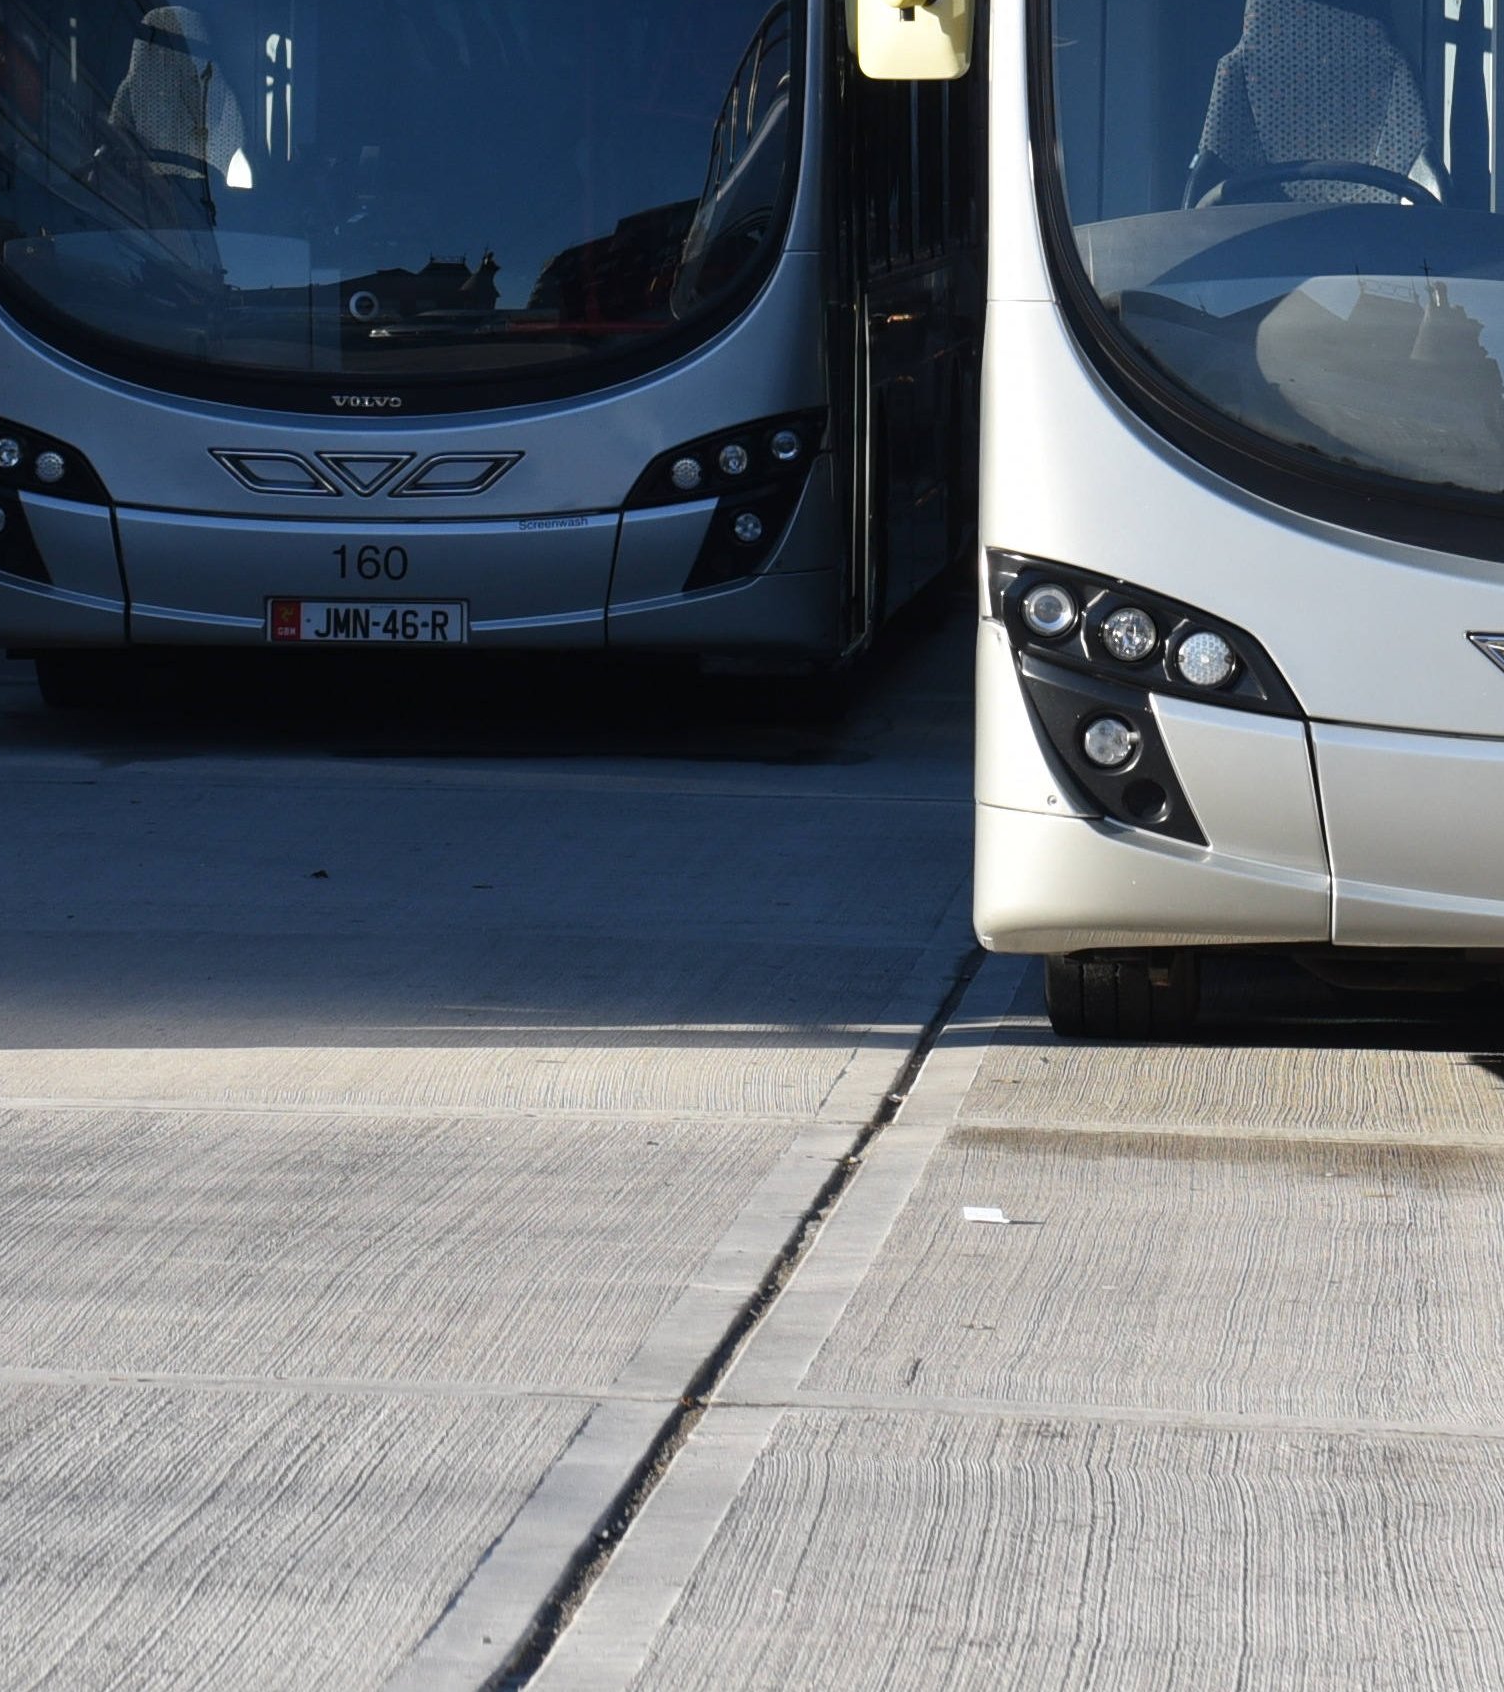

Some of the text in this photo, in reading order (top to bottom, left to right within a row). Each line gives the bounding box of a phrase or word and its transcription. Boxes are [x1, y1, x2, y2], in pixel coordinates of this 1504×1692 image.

[331, 395, 402, 408] VOLVO
[518, 516, 589, 532] Screenwash
[332, 544, 408, 581] 160
[314, 607, 449, 641] JMN-46-R
